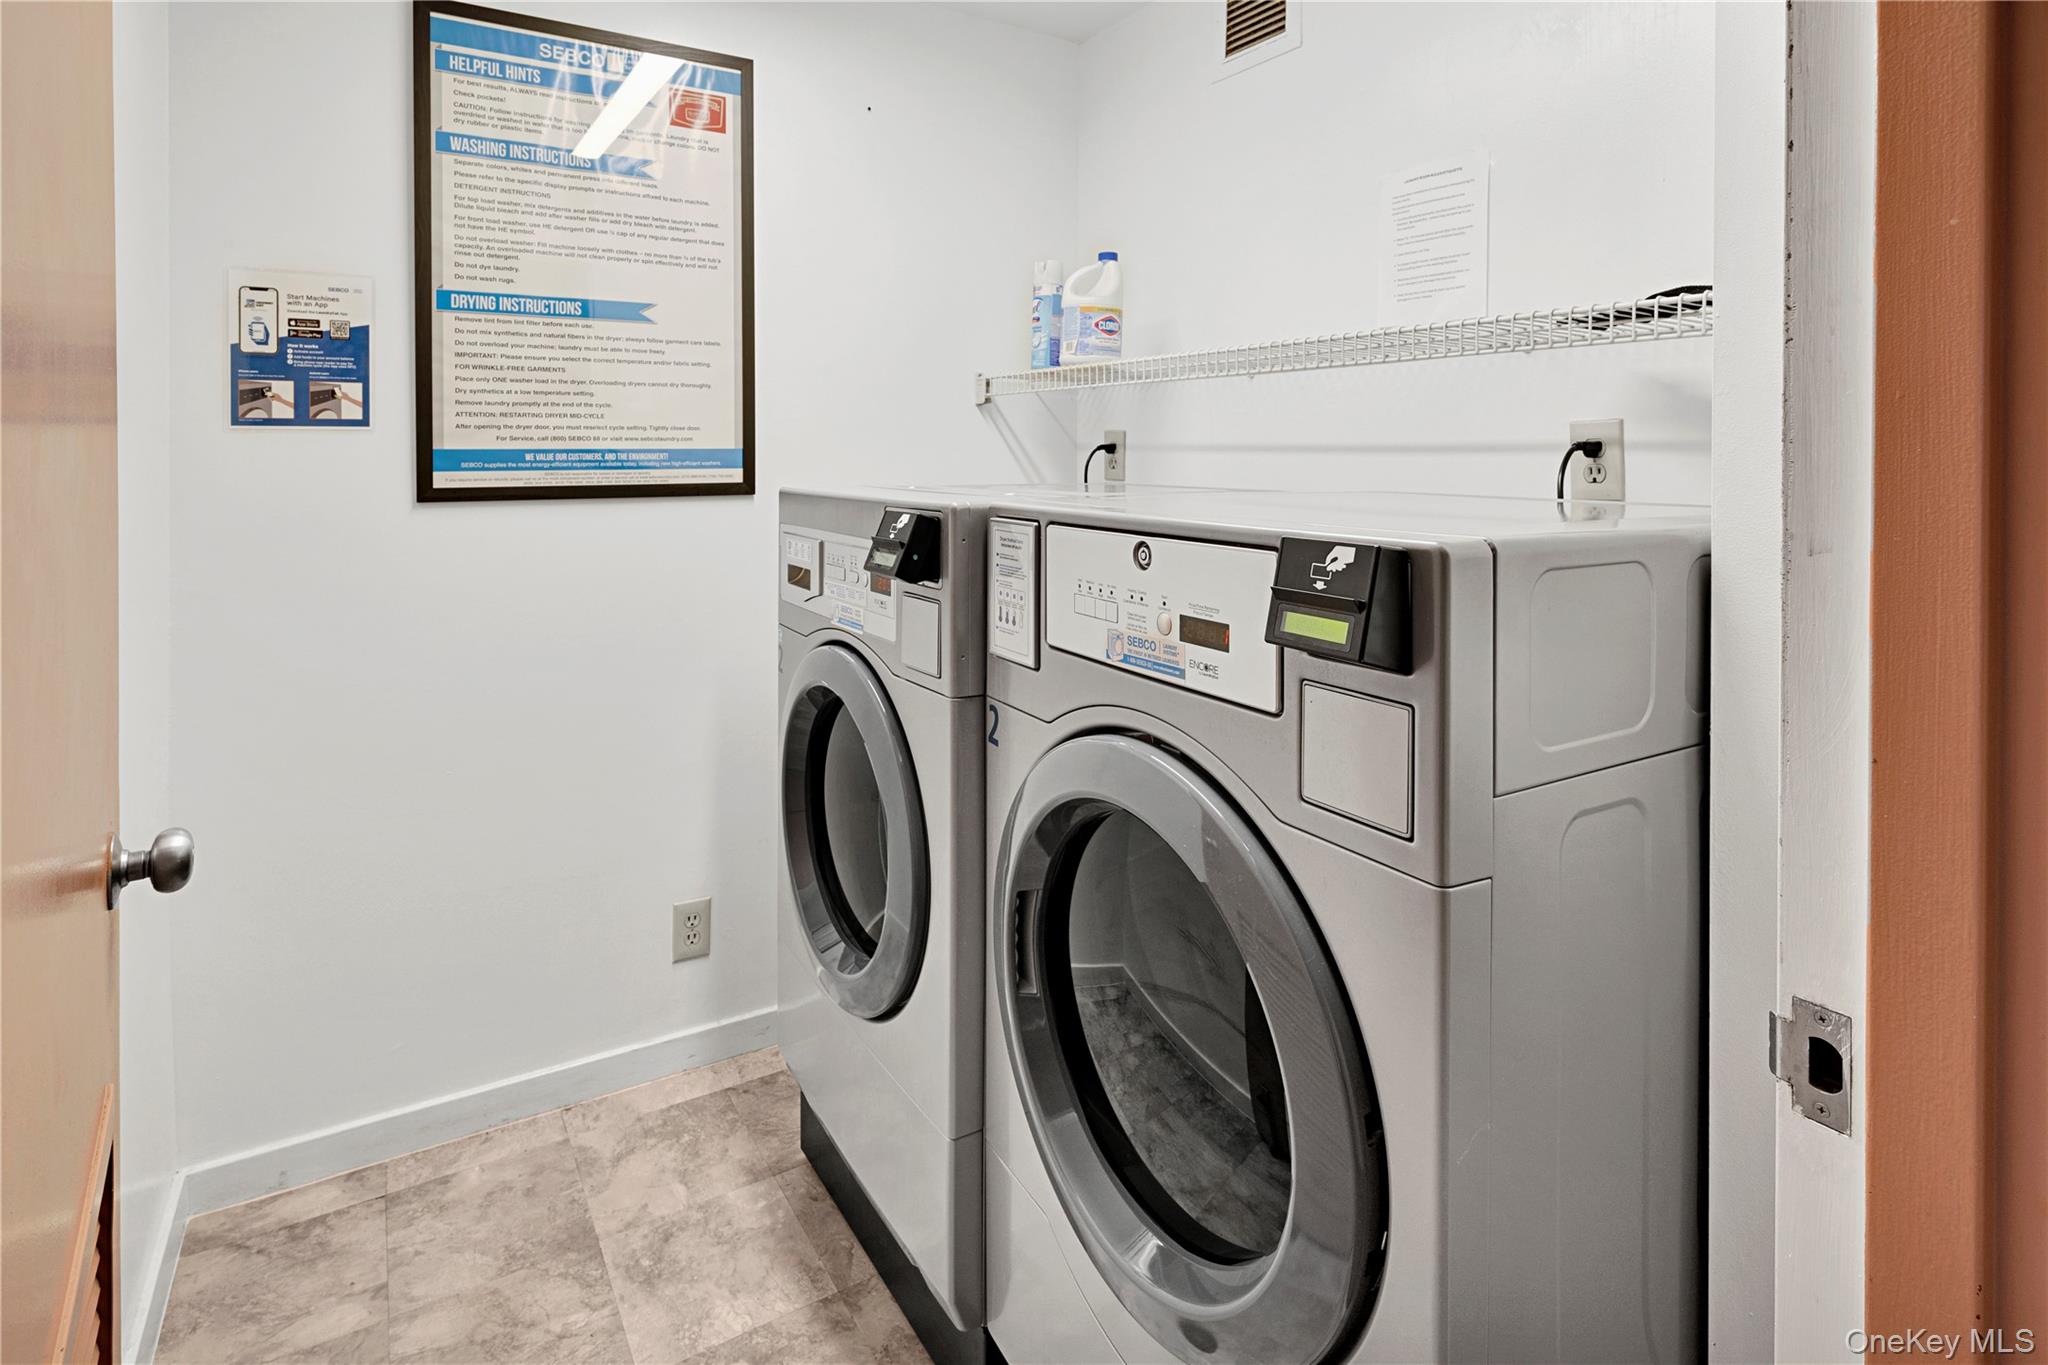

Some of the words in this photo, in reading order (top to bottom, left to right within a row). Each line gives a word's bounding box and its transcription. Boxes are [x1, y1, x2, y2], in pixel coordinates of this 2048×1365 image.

[540, 43, 605, 68] SEBCO
[448, 54, 502, 77] HELPFUL
[505, 63, 541, 84] HINTS
[449, 135, 506, 157] WASHING
[508, 143, 591, 168] INSTRUCTIONS
[453, 182, 498, 193] DETERGENT
[499, 187, 551, 199] INSTRUCTIONS
[306, 295, 340, 303] Machines
[450, 292, 496, 310] DRYING
[498, 296, 582, 315] INSTRUCTIONS
[511, 400, 541, 408] promptly
[524, 452, 534, 461] WE
[535, 452, 554, 461] VALUE
[554, 452, 567, 461] OUR
[604, 452, 616, 460] AND
[617, 452, 627, 460] THE
[628, 452, 668, 460] ENVIRONMENT!
[1127, 635, 1157, 652] SEBCO
[988, 704, 999, 747] 2
